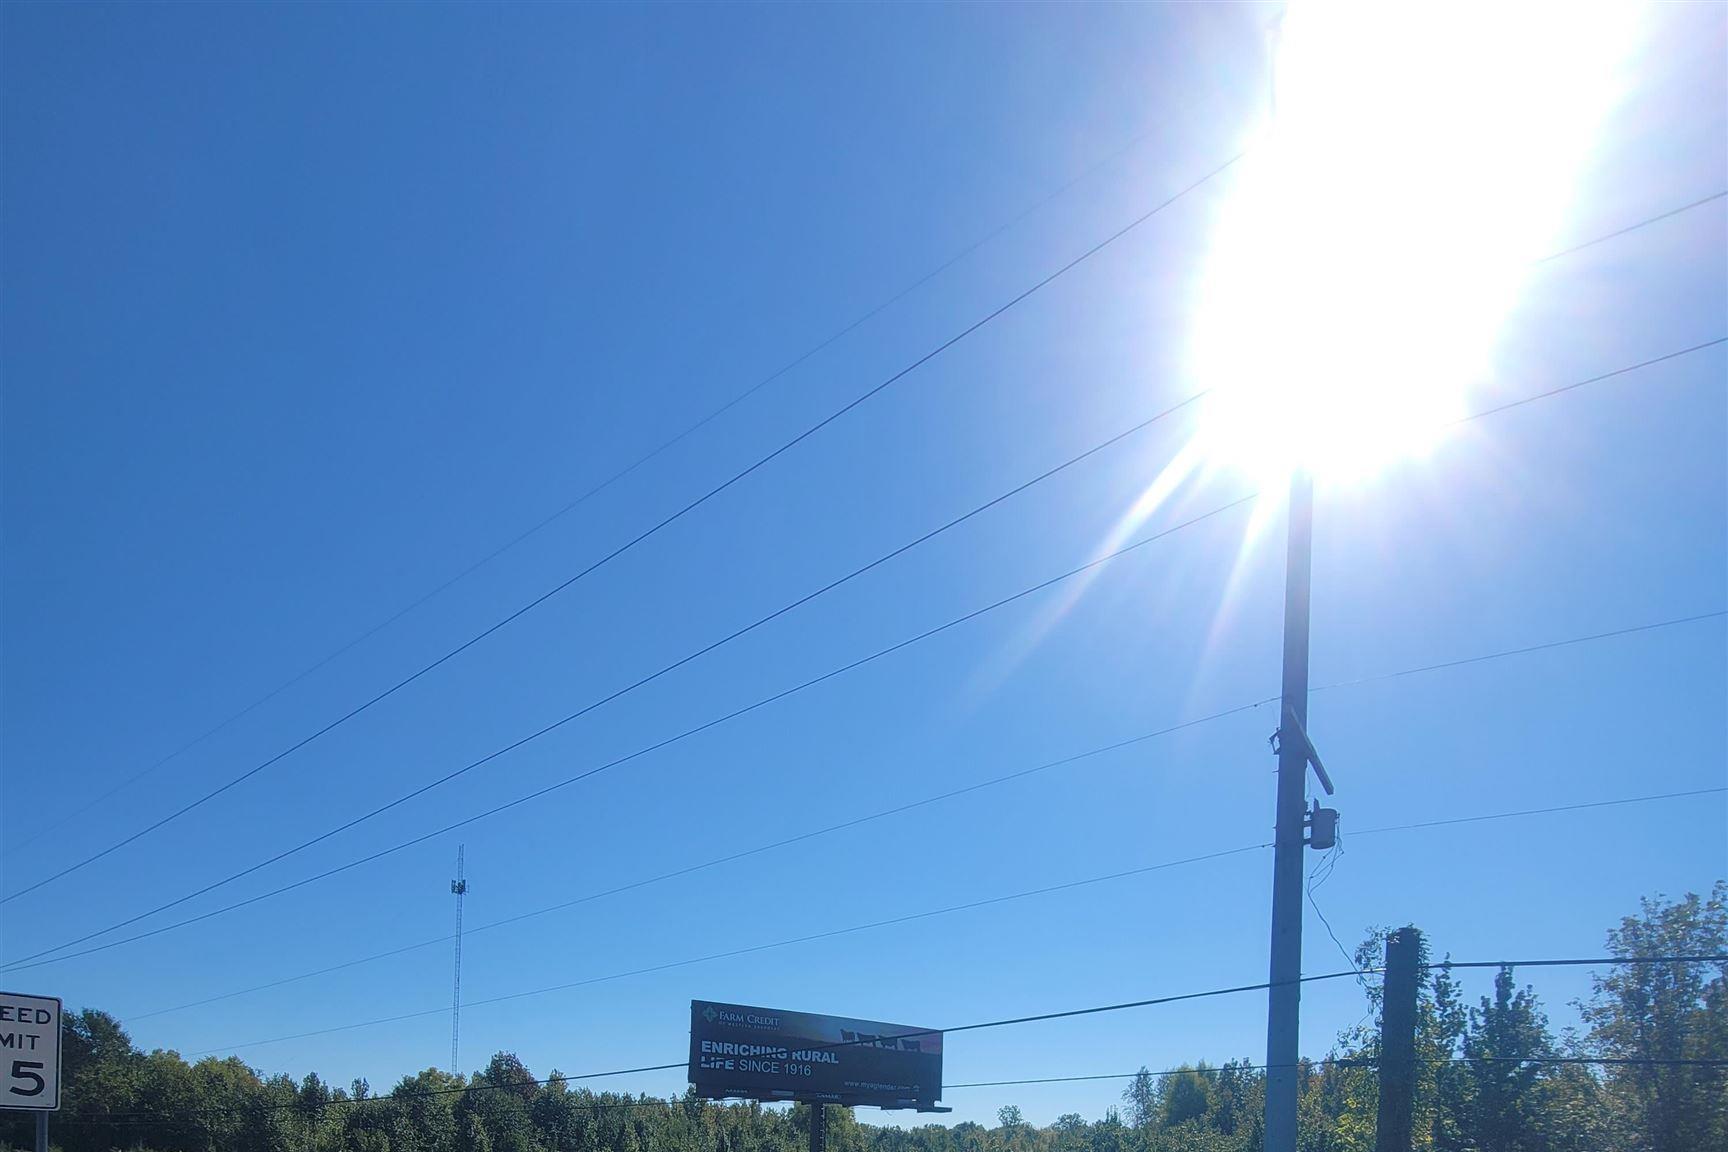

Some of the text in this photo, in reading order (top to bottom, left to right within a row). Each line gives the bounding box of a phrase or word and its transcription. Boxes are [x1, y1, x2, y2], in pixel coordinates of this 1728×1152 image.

[719, 1010, 744, 1023] FARM
[747, 1014, 781, 1026] CREDIT
[701, 1039, 839, 1064] ENRICHING RURAL
[700, 1055, 811, 1076] LIFE SINCE 1916
[9, 1060, 45, 1097] 5
